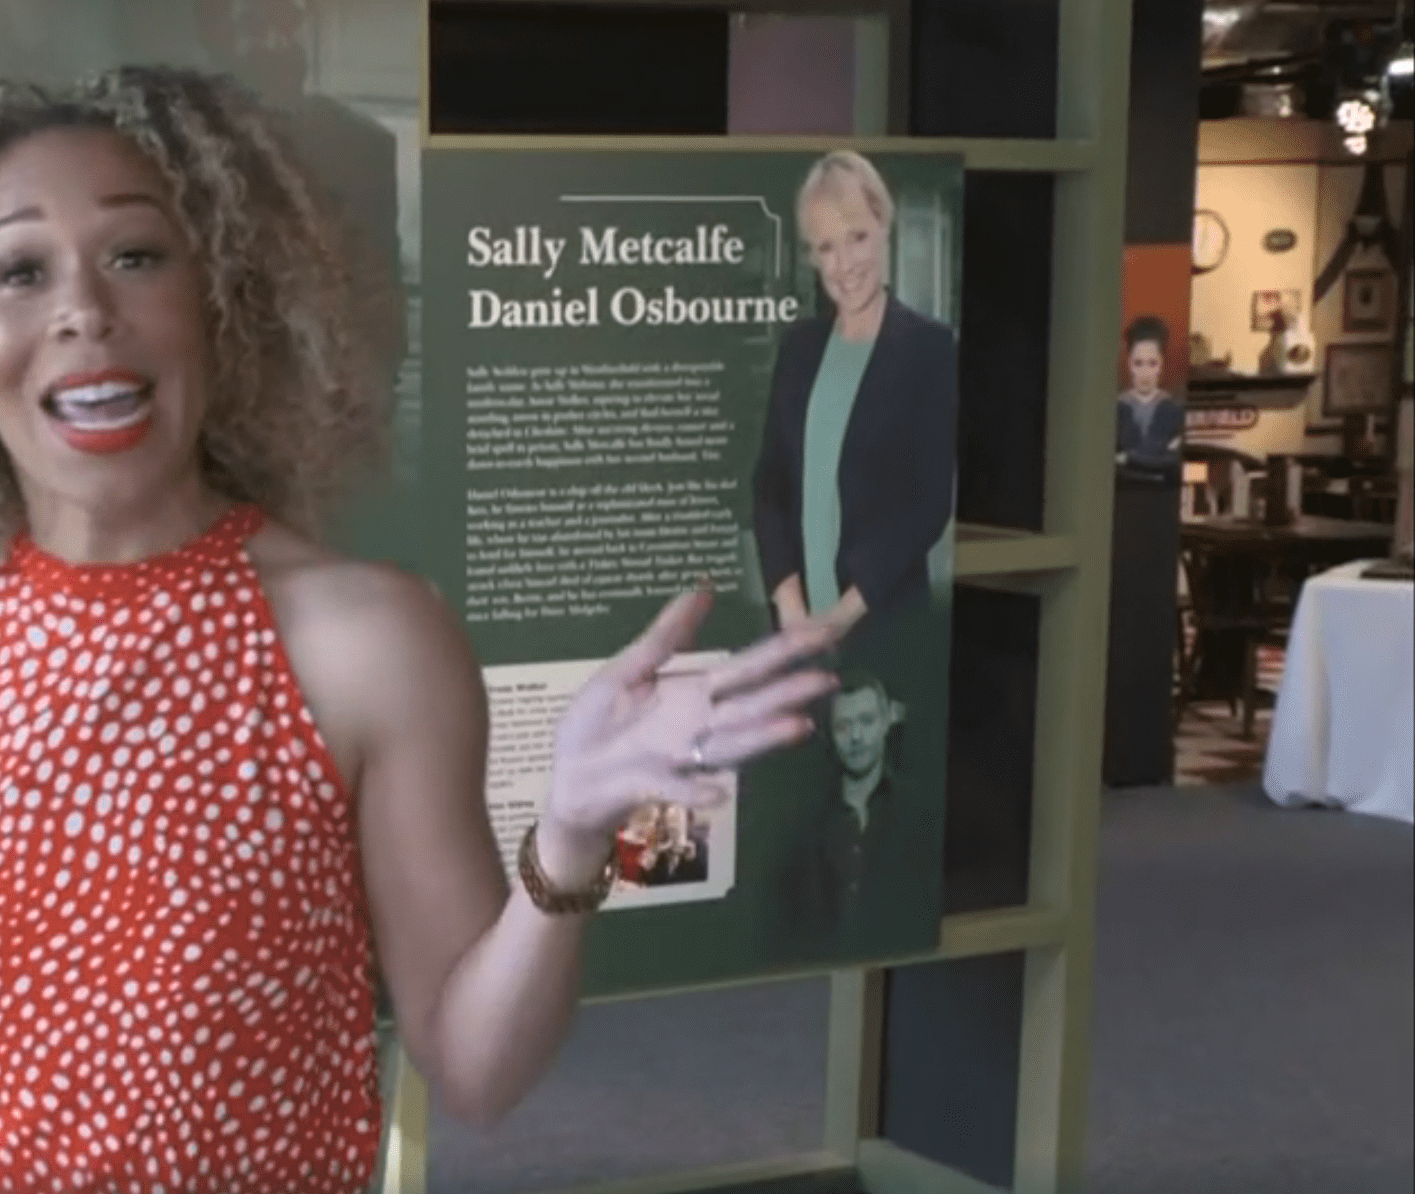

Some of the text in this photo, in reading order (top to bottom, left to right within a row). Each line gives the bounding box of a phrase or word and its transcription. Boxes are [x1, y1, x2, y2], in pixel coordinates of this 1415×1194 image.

[467, 223, 745, 280] Sally Metcalfe
[468, 286, 799, 328] Daniel Osbourne
